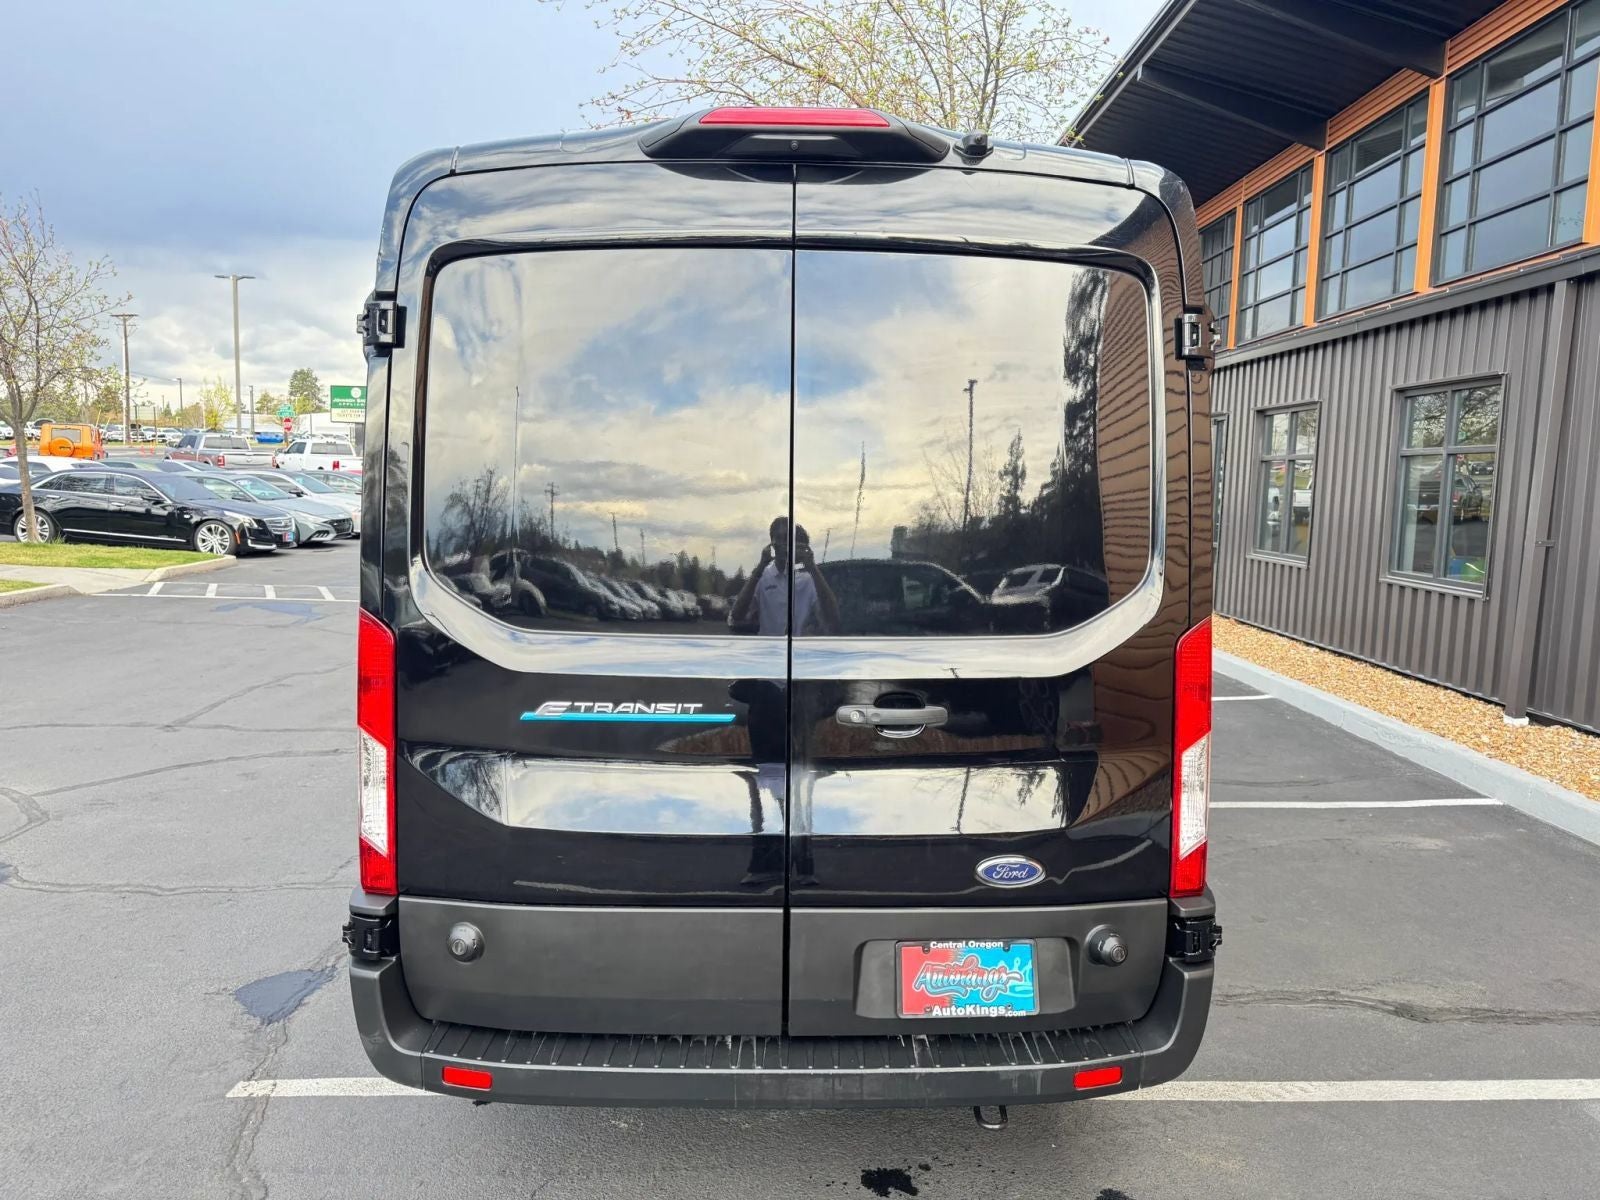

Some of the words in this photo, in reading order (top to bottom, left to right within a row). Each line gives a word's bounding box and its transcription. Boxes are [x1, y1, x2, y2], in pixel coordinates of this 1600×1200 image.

[992, 863, 1029, 879] Ford
[929, 940, 966, 950] Central
[967, 940, 1004, 950] Oregon
